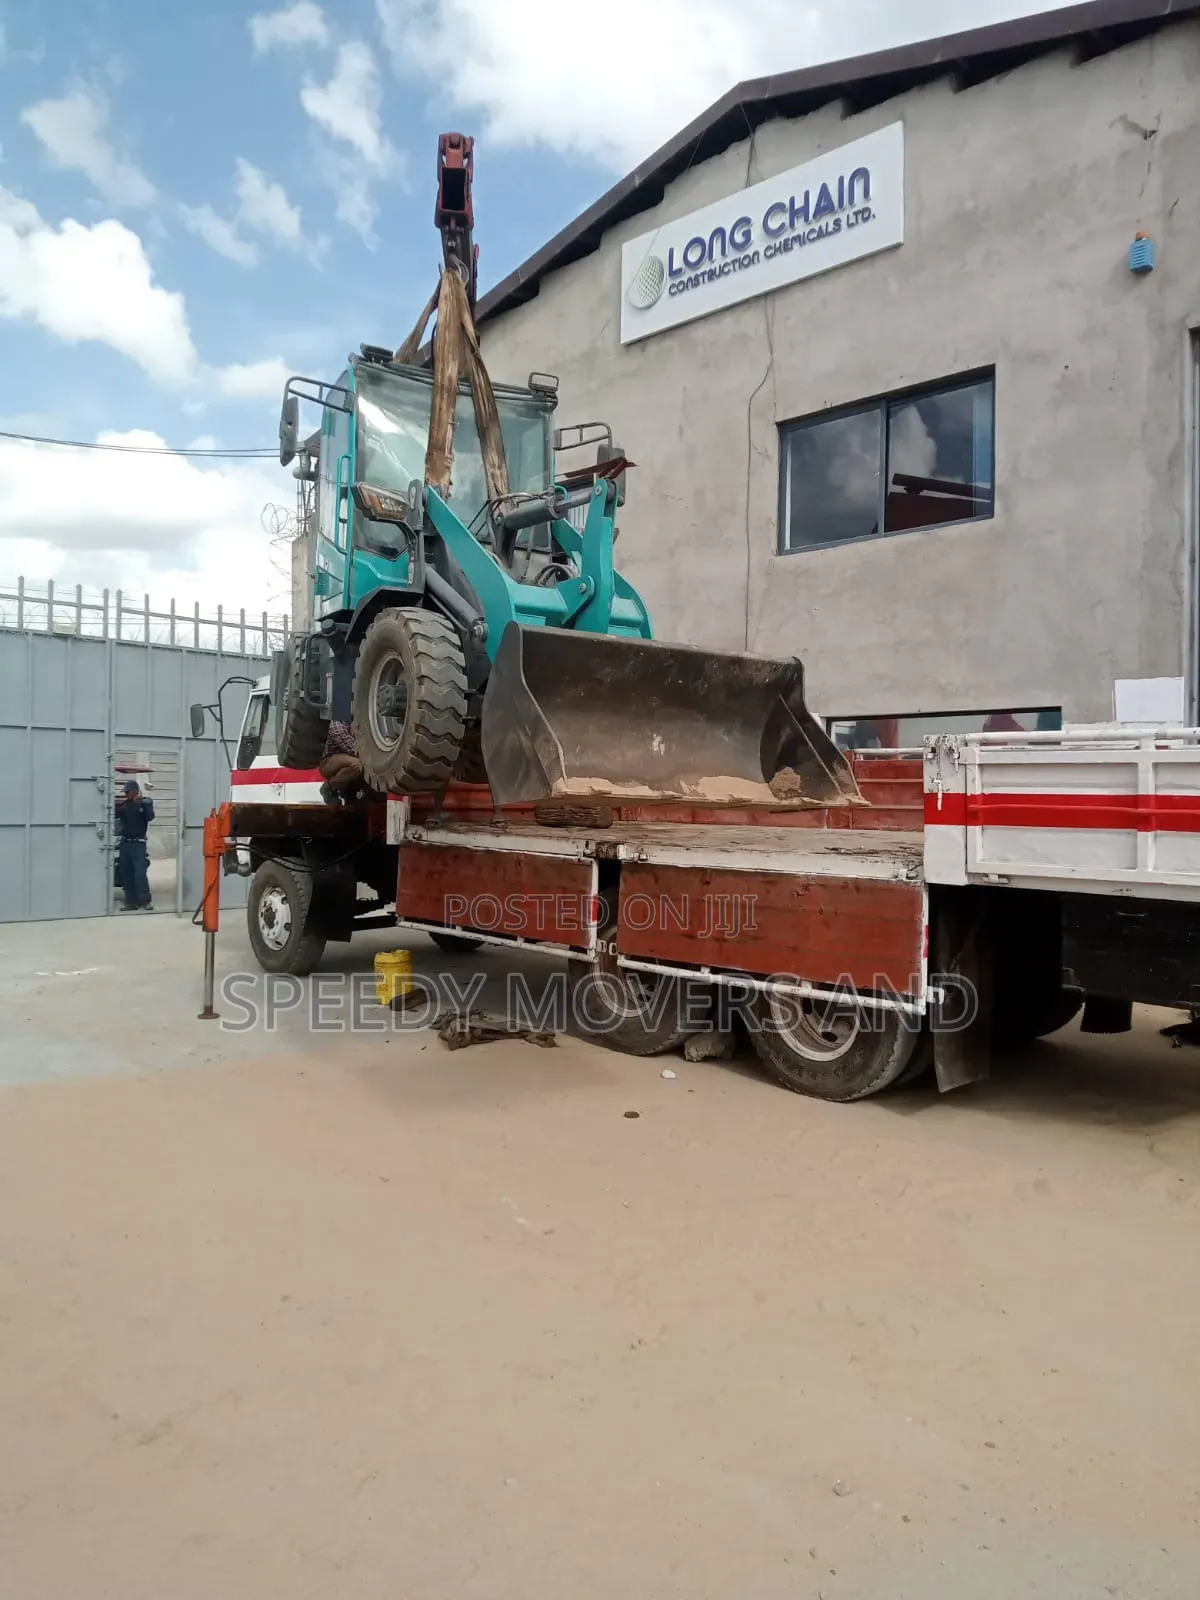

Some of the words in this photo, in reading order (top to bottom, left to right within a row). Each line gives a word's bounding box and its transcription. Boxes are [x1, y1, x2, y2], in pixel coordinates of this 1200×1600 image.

[668, 216, 752, 277] LONG
[762, 166, 870, 237] CHAIN
[668, 250, 760, 296] CONSTRUCTION
[764, 217, 842, 259] CHEMICALS
[846, 207, 876, 228] LTD.
